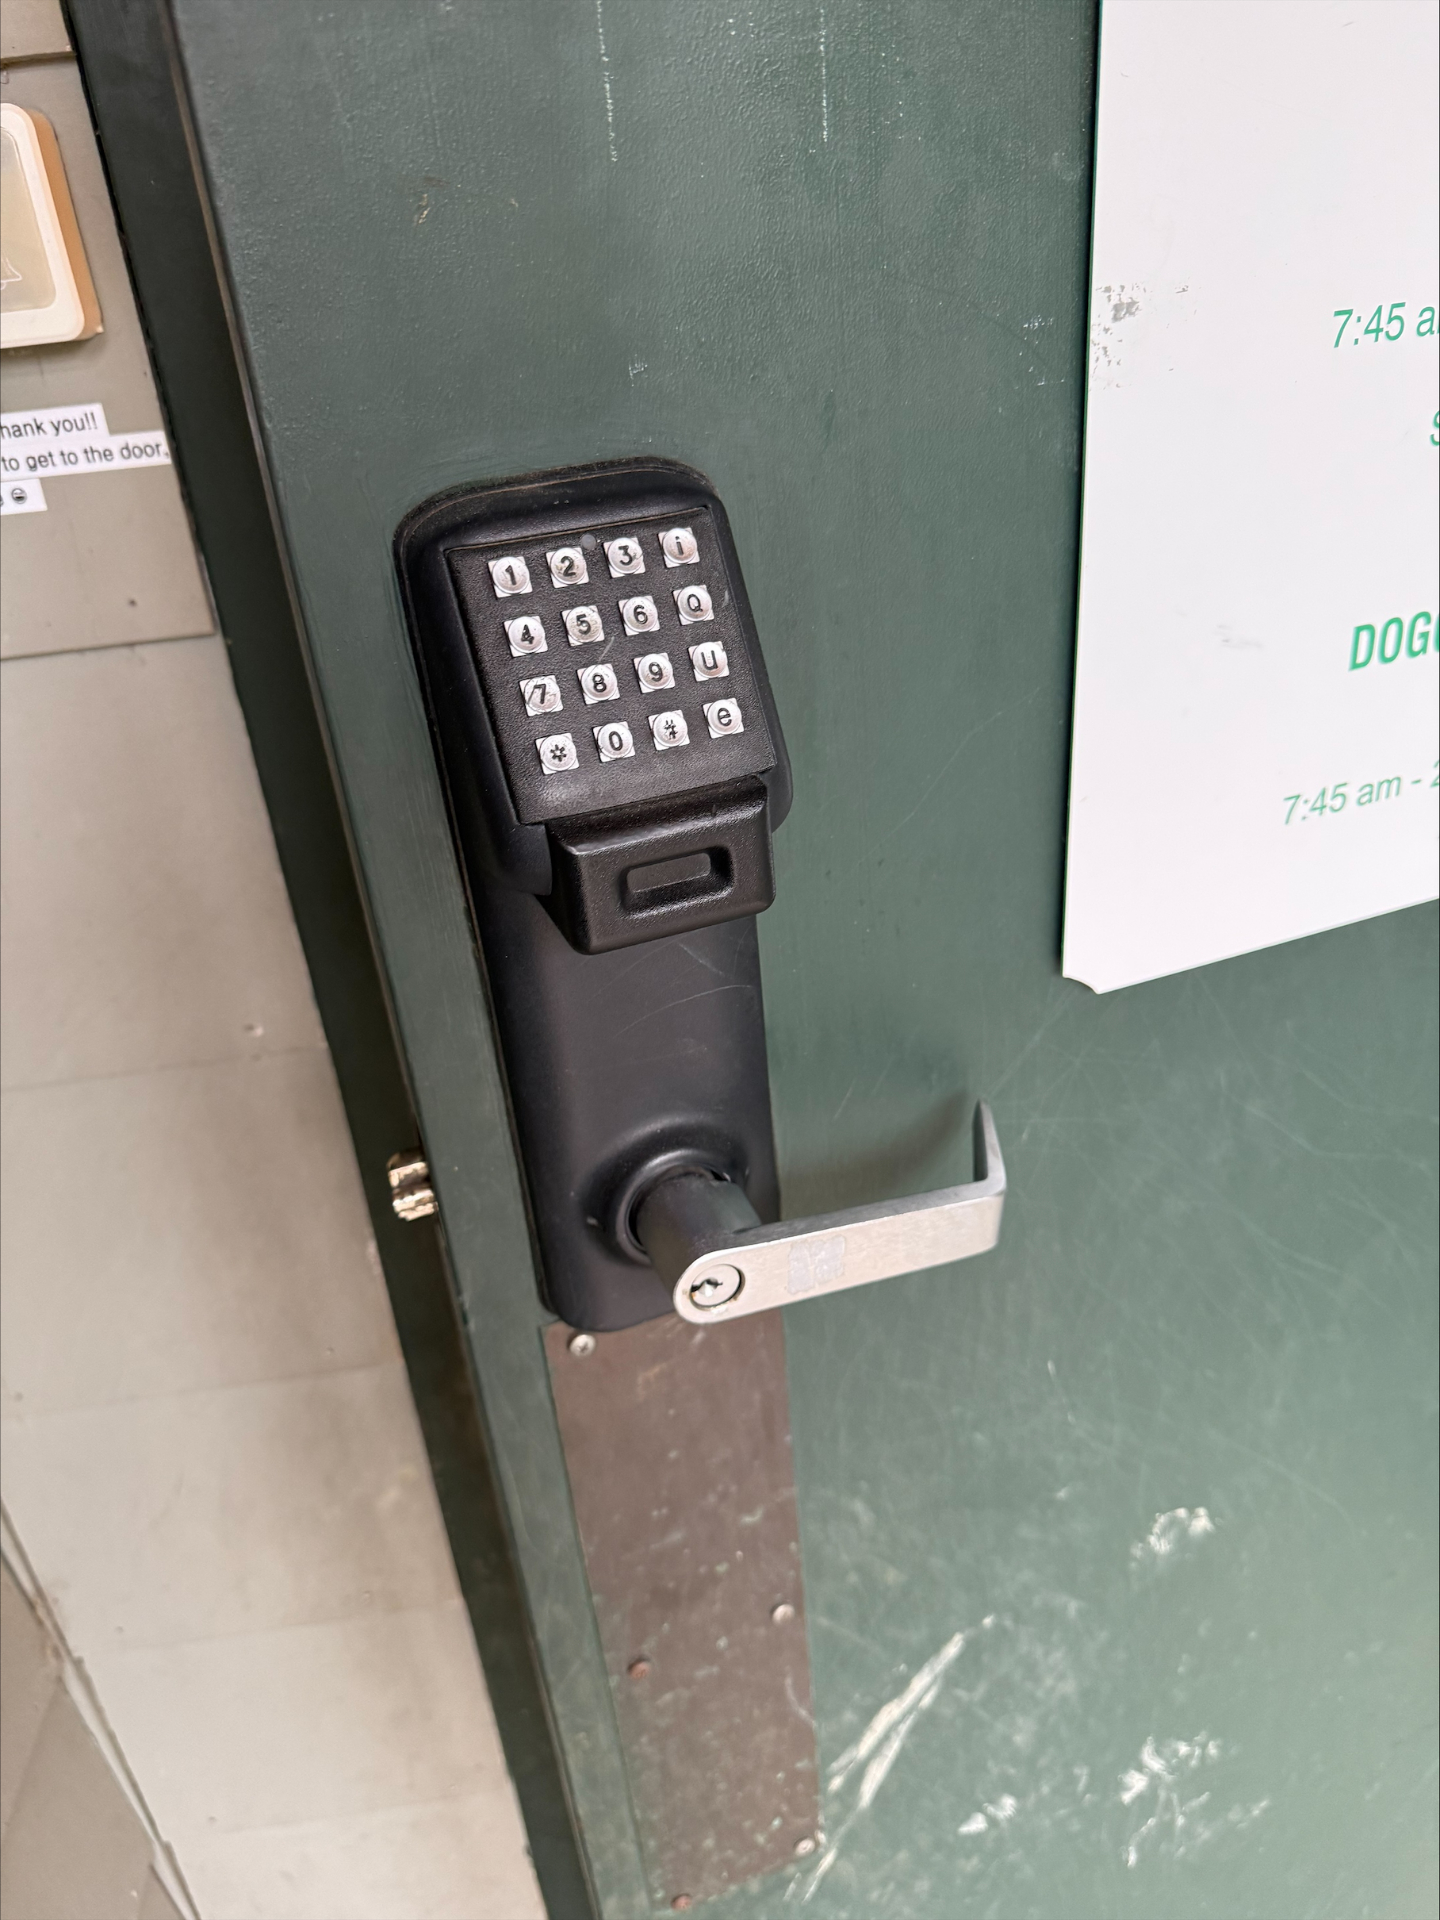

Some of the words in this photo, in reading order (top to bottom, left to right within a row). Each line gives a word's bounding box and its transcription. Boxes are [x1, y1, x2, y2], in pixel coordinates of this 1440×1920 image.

[1333, 301, 1406, 349] 7:45
[1416, 306, 1440, 337] a
[50, 412, 98, 436] you!!
[2, 456, 20, 472] to
[26, 452, 57, 472] get
[60, 451, 78, 466] to
[84, 446, 114, 464] the
[505, 565, 516, 586] 1
[560, 556, 576, 577] 2
[618, 545, 633, 565] 3
[675, 536, 684, 556] i
[521, 624, 535, 645] 4
[576, 614, 592, 635] 5
[633, 604, 648, 624] 6
[687, 593, 703, 612] Q
[1349, 611, 1440, 672] DOG
[532, 683, 547, 704] 7
[592, 673, 607, 692] 8
[648, 661, 663, 682] 9
[717, 707, 732, 727] e
[1283, 782, 1349, 825] 7:45
[1356, 776, 1401, 807] am
